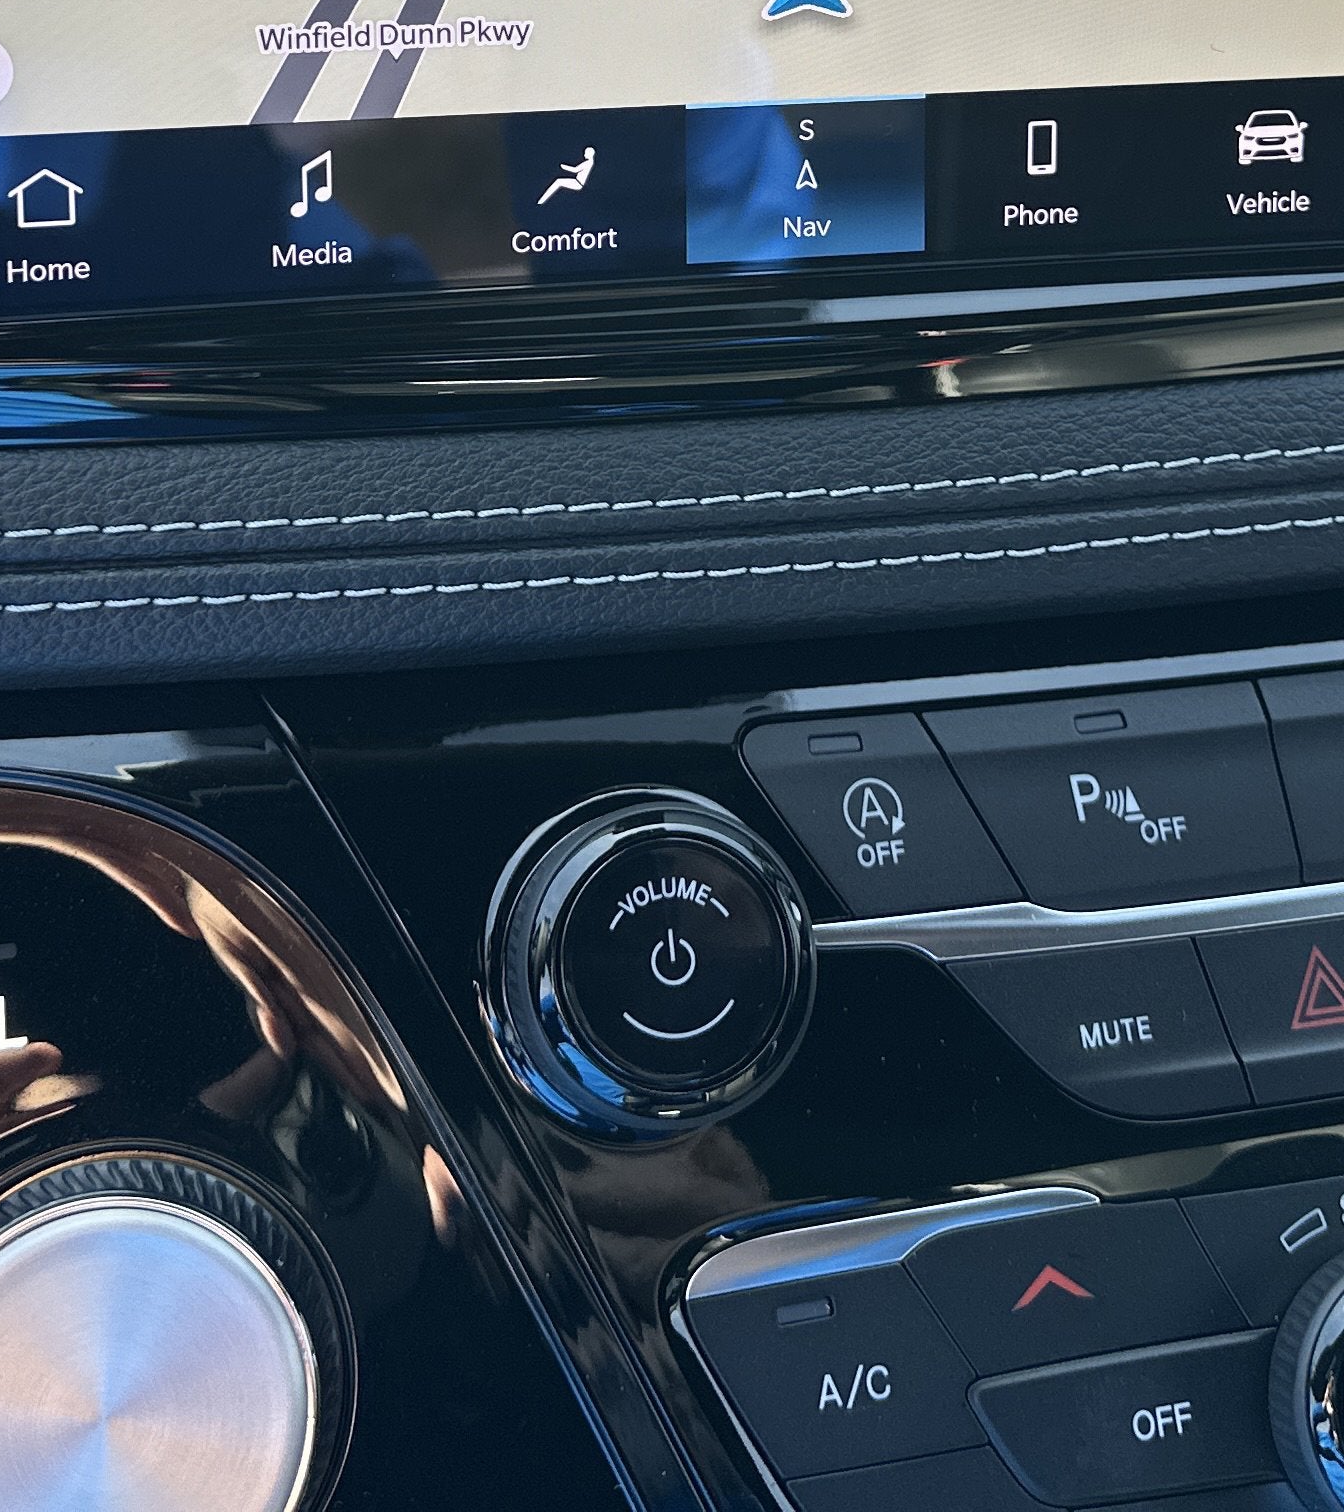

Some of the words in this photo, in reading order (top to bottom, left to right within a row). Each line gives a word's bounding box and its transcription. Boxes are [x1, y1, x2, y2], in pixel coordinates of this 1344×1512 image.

[258, 23, 371, 51] Winfield
[378, 22, 452, 48] Dunn
[460, 19, 531, 50] Pkwy
[798, 119, 816, 142] S
[1003, 203, 1079, 228] Phone
[1226, 189, 1310, 216] Vehicle
[511, 227, 618, 254] Comfort
[783, 215, 832, 239] Nav
[271, 241, 353, 269] Media
[6, 257, 91, 284] Home
[1140, 815, 1188, 844] OFF
[857, 839, 905, 868] OFF
[617, 876, 712, 915] VOLUME
[1079, 1015, 1154, 1050] MUTE
[817, 1364, 892, 1411] A/C
[1131, 1400, 1193, 1442] OFF
